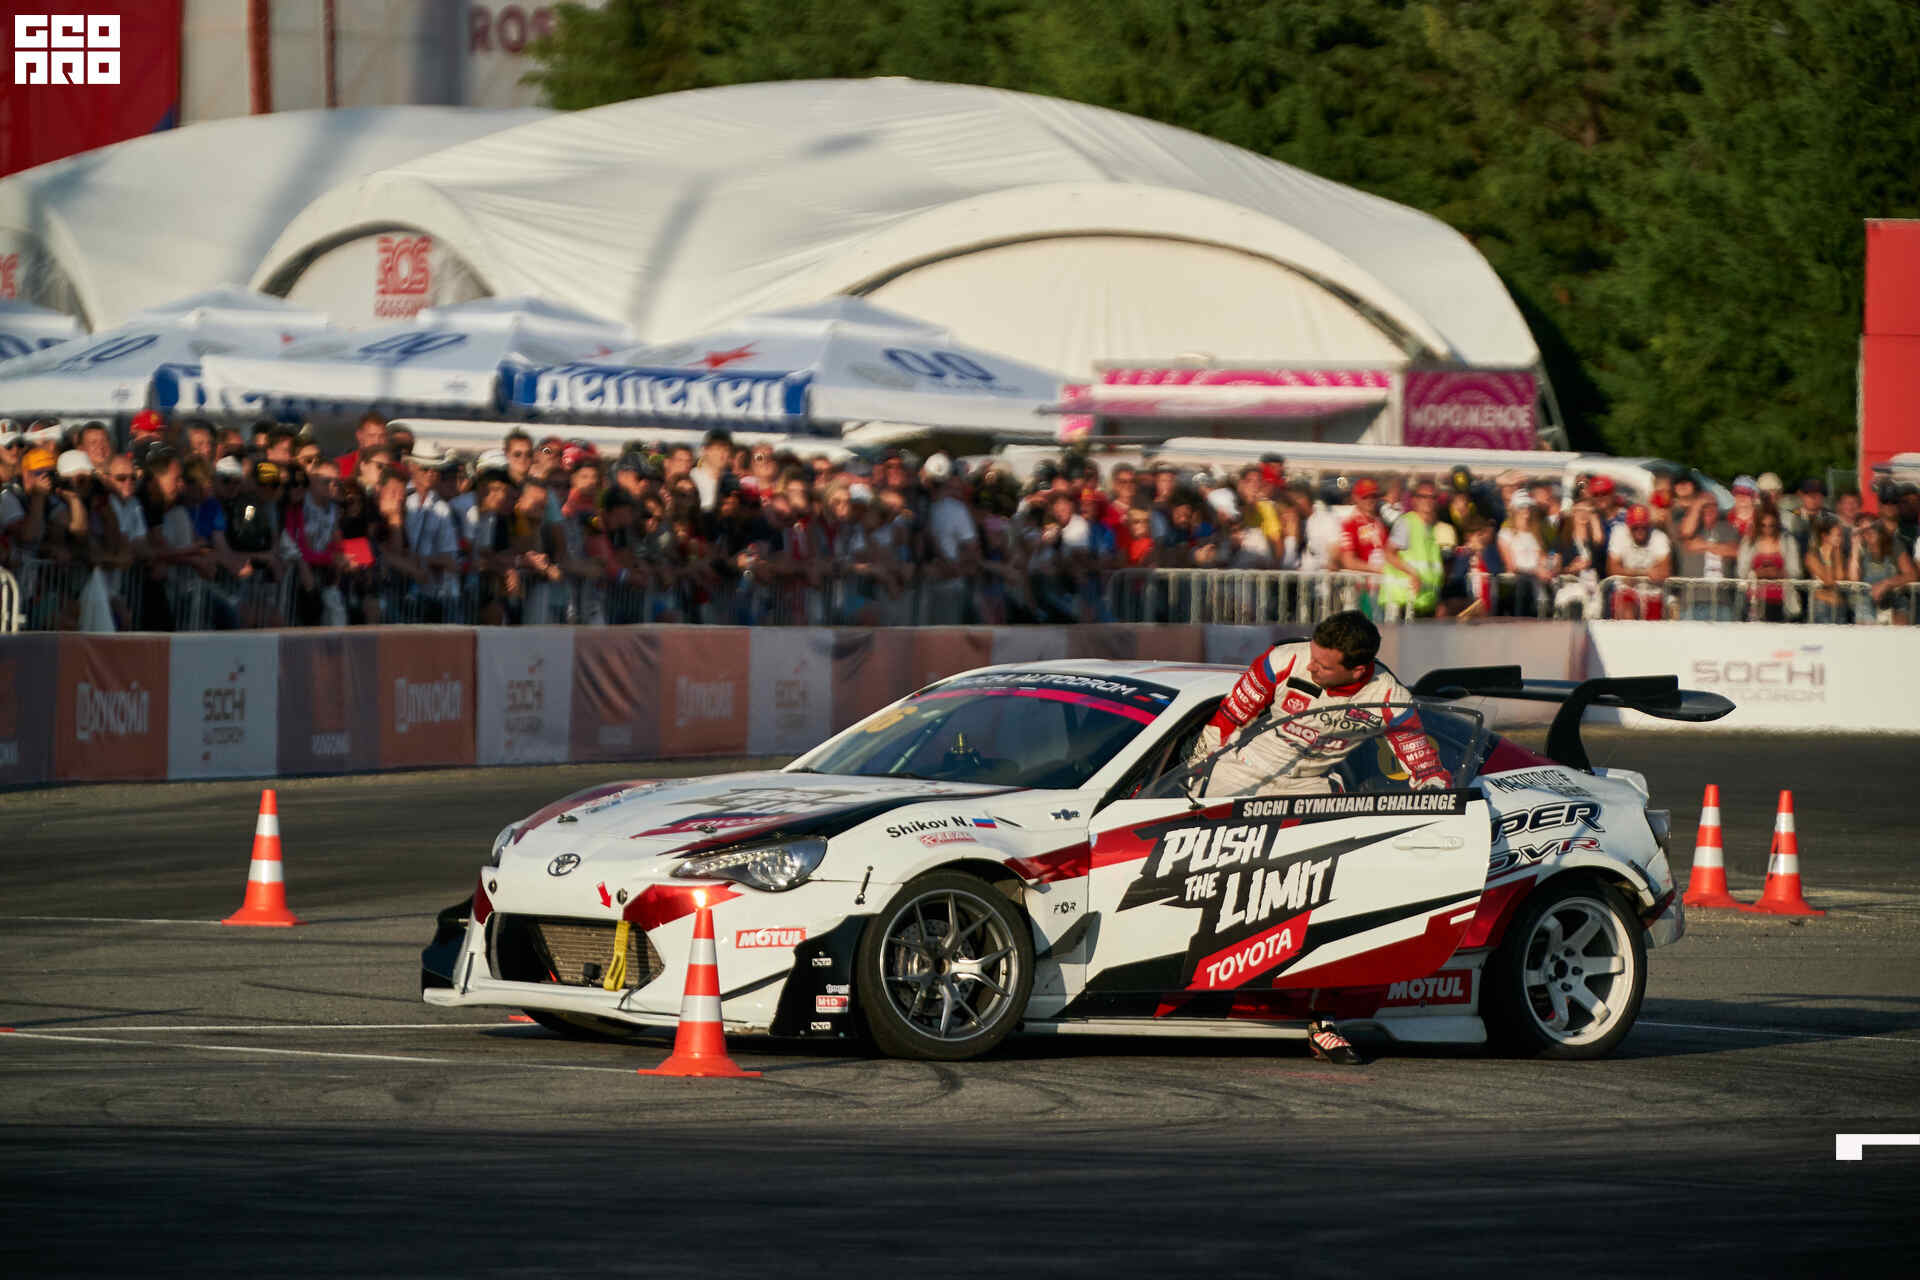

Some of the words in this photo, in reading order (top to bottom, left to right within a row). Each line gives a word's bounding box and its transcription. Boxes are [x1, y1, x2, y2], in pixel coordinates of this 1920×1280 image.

[1014, 672, 1139, 696] AUTODROM
[1693, 660, 1826, 686] SOCHI
[1243, 799, 1288, 817] SOCHI
[1293, 796, 1375, 815] GYMKHANA
[1376, 793, 1457, 812] CHALLENGE
[886, 818, 948, 838] Shikov
[950, 815, 973, 828] N.
[1156, 823, 1268, 878] PUSH
[1184, 871, 1219, 902] THE
[1214, 857, 1332, 934] LIMIT
[738, 929, 801, 947] MOTUL
[1206, 928, 1293, 988] TOYOTA
[1387, 976, 1465, 1000] MOTUL
